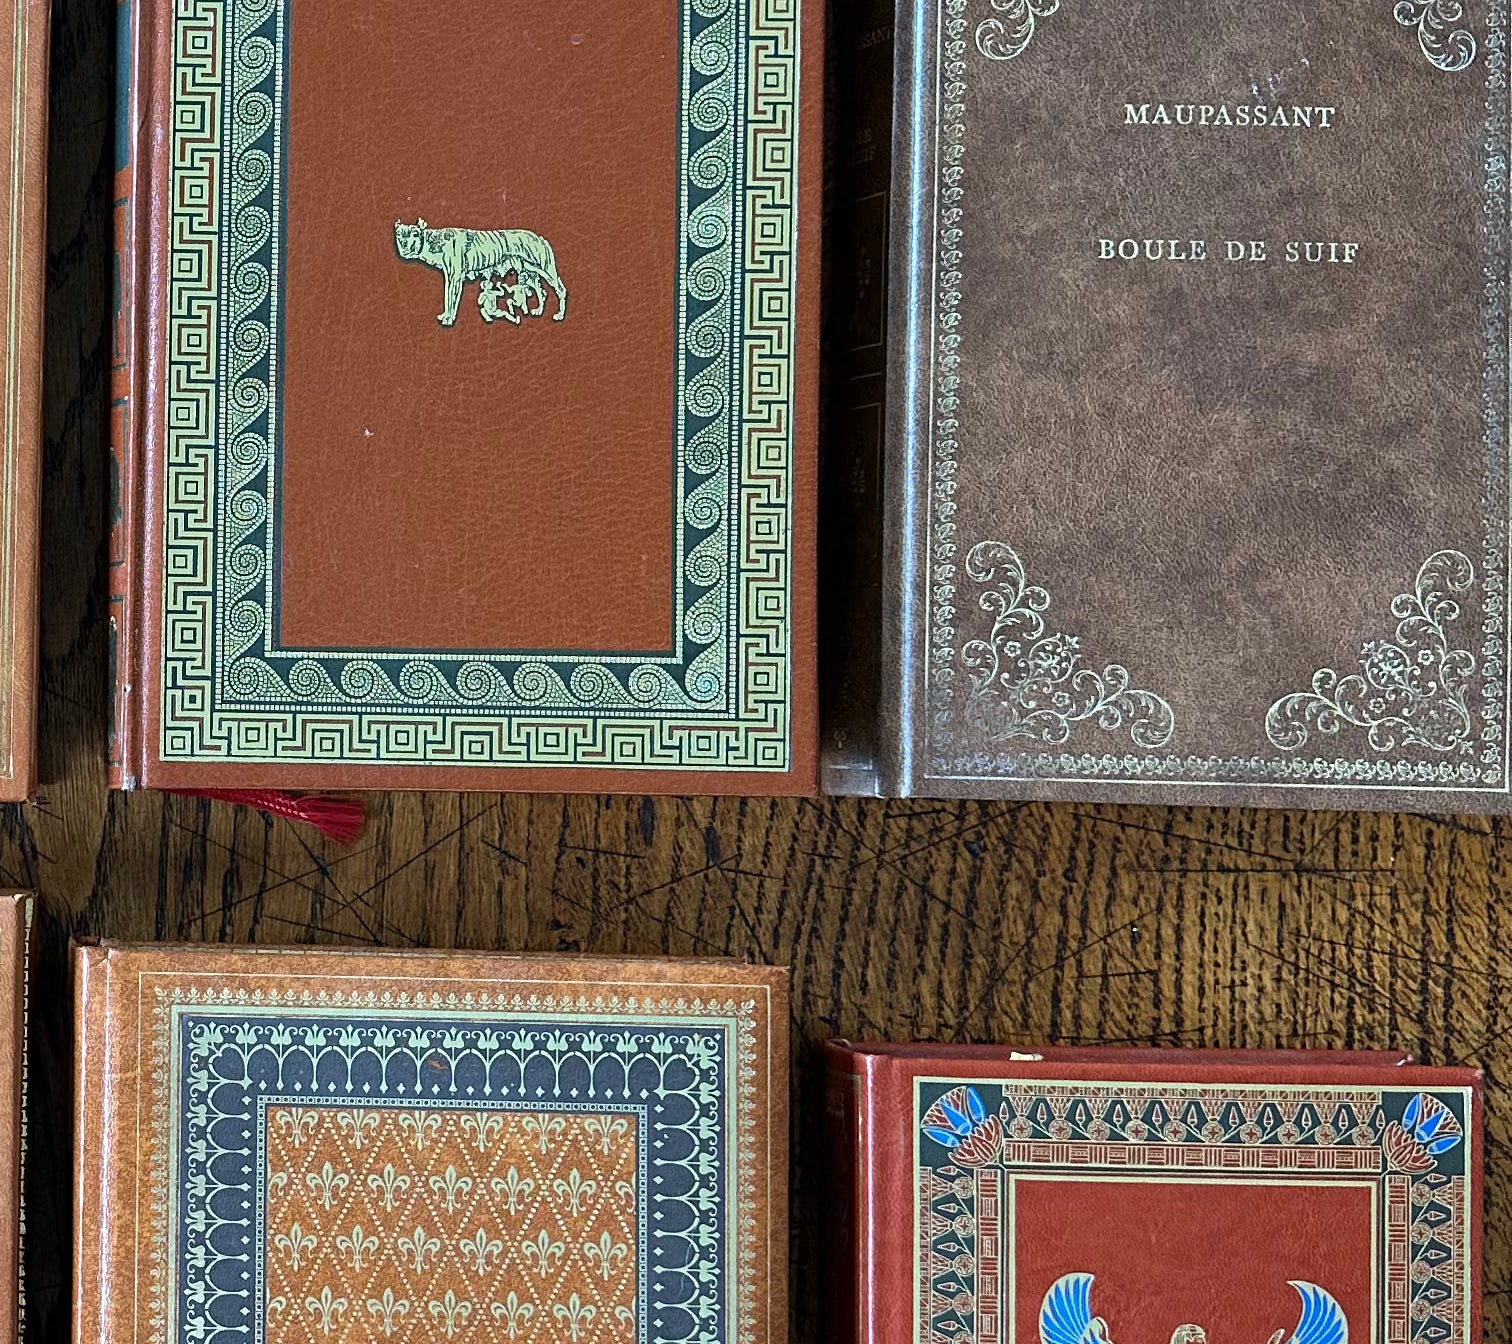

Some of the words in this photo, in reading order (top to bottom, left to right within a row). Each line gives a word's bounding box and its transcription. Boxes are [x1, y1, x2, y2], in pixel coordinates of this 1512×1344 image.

[1124, 103, 1336, 128] MAUPASSANT
[1098, 238, 1207, 260] BOULE
[1224, 240, 1267, 261] DE
[1285, 241, 1360, 263] SUIF
